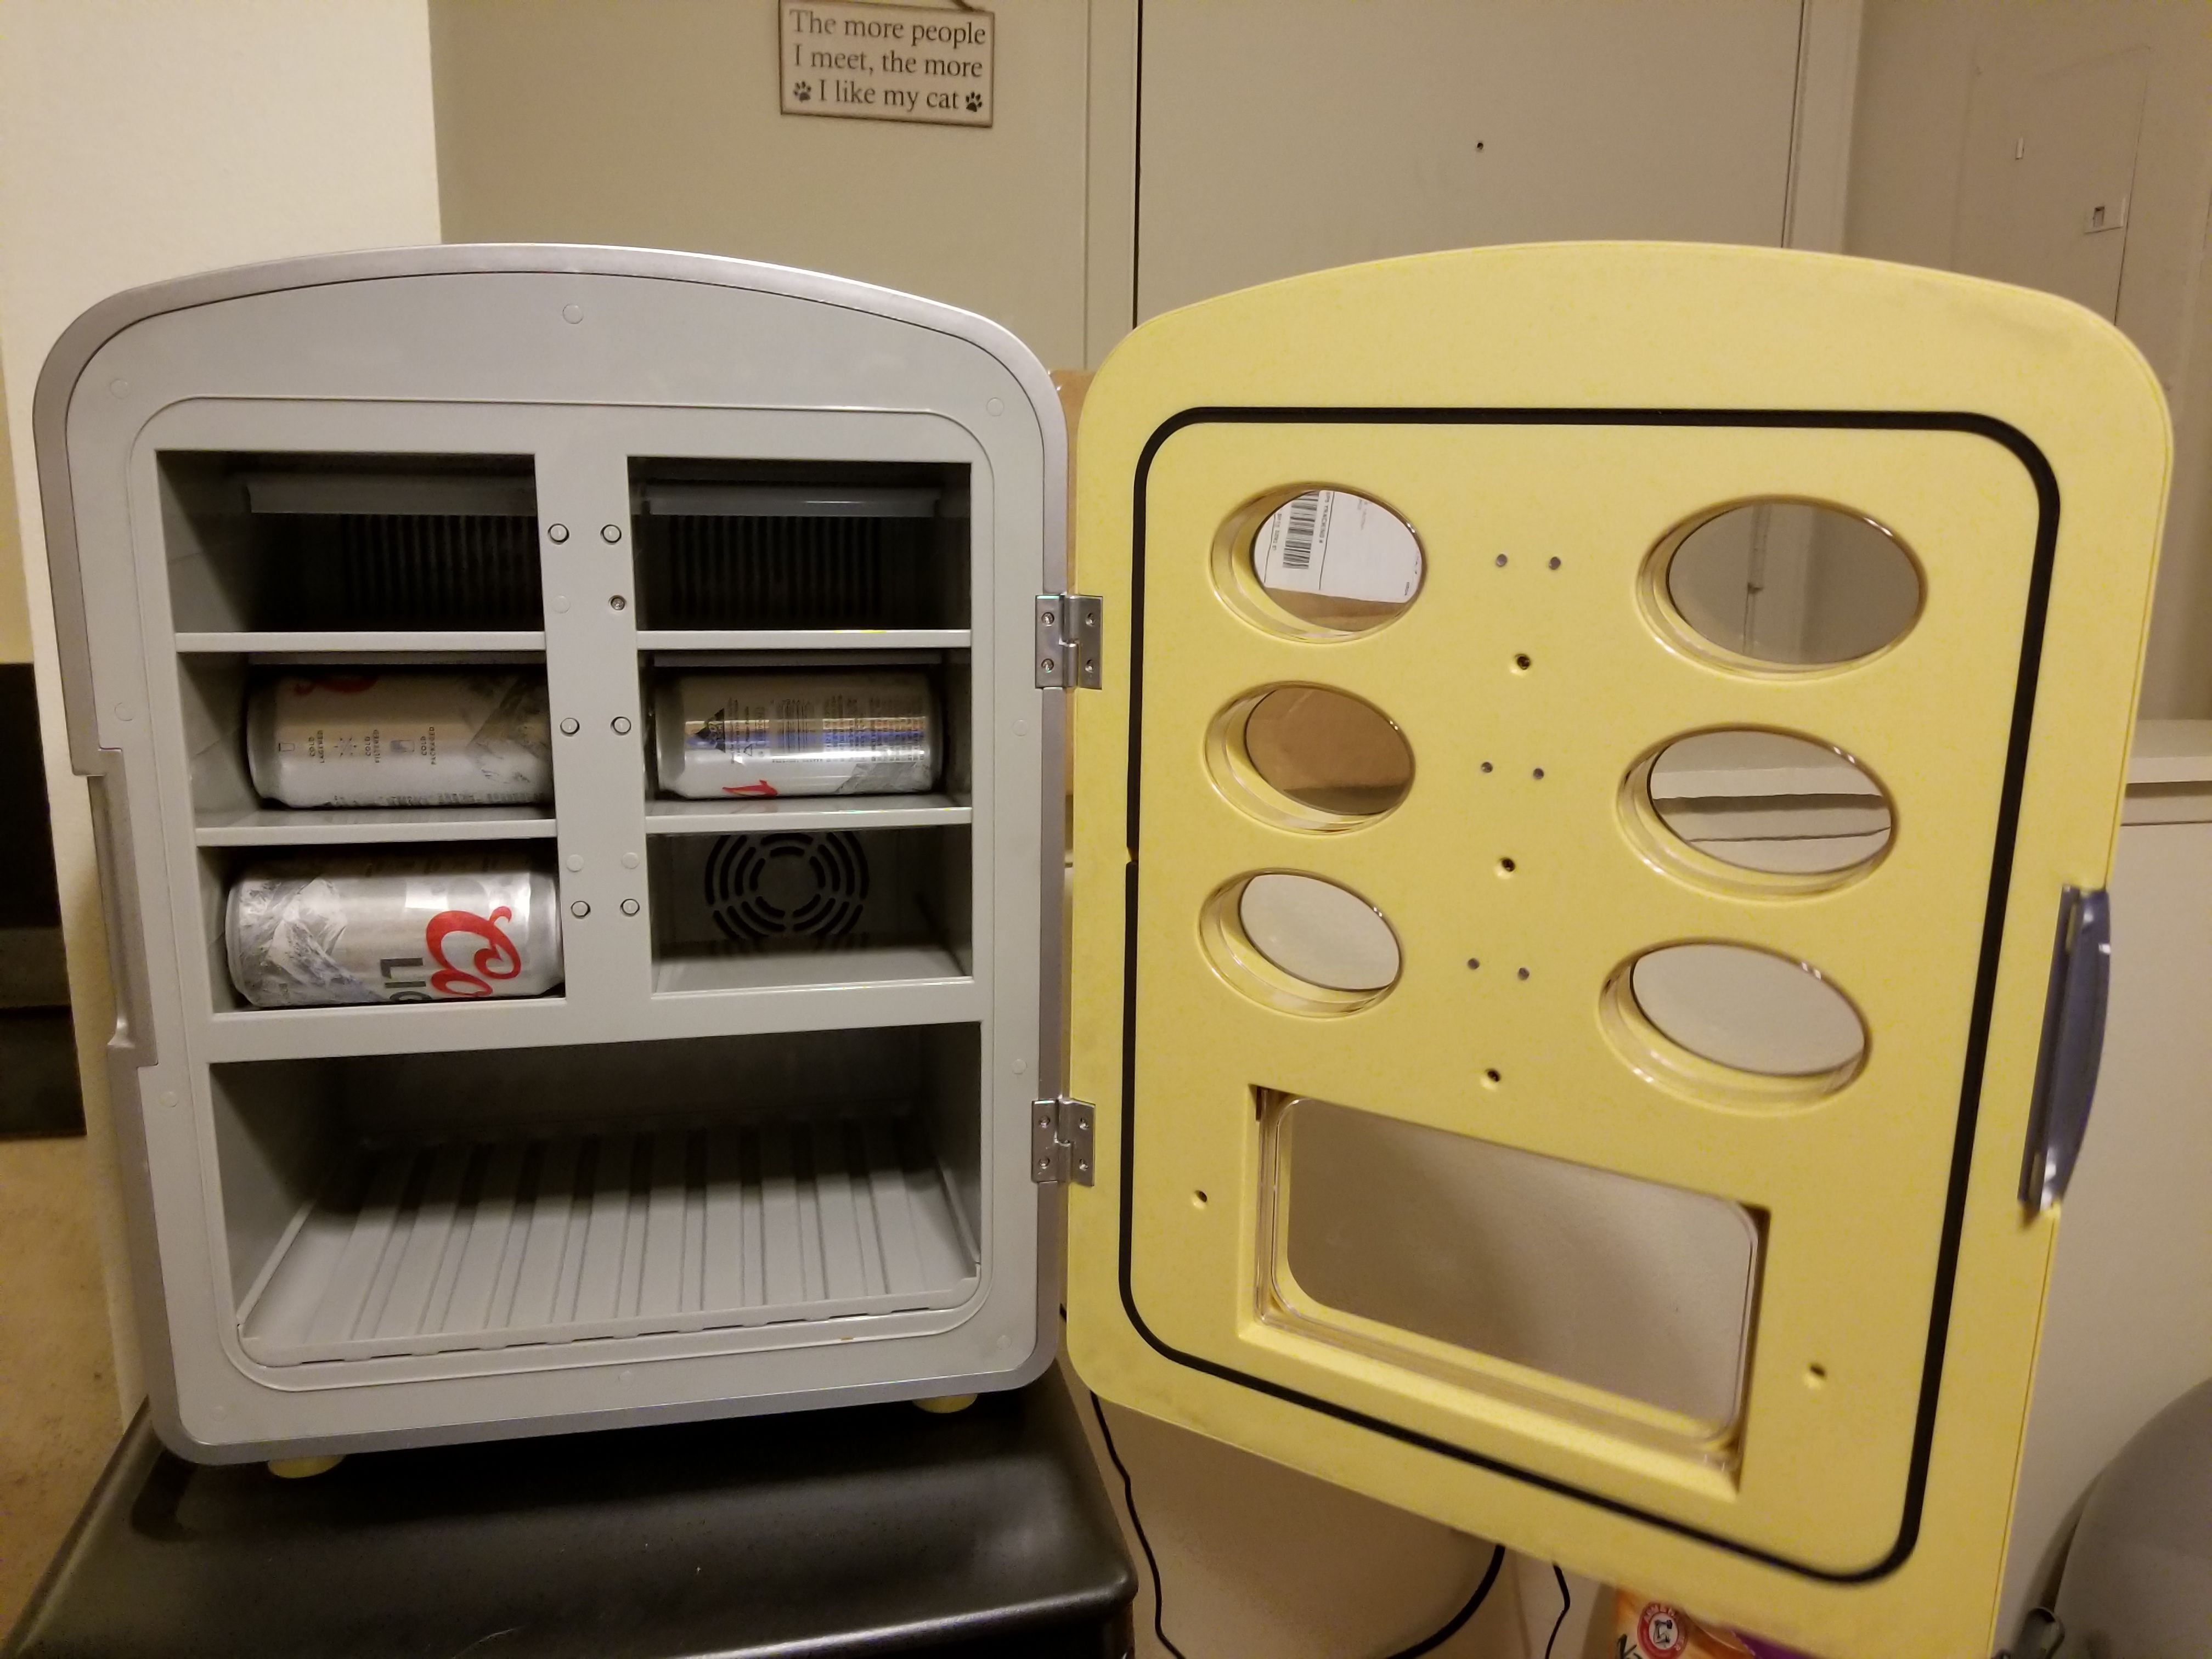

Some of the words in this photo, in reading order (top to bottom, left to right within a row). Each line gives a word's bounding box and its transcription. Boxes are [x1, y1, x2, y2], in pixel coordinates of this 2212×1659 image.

[789, 9, 836, 35] The
[845, 19, 904, 39] more
[911, 21, 986, 49] people
[794, 43, 802, 66] I
[811, 50, 873, 74] meet,
[882, 50, 916, 74] the
[924, 58, 983, 77] more
[820, 79, 827, 101] I
[836, 80, 876, 104] like
[884, 88, 919, 112] my
[927, 91, 960, 109] cat
